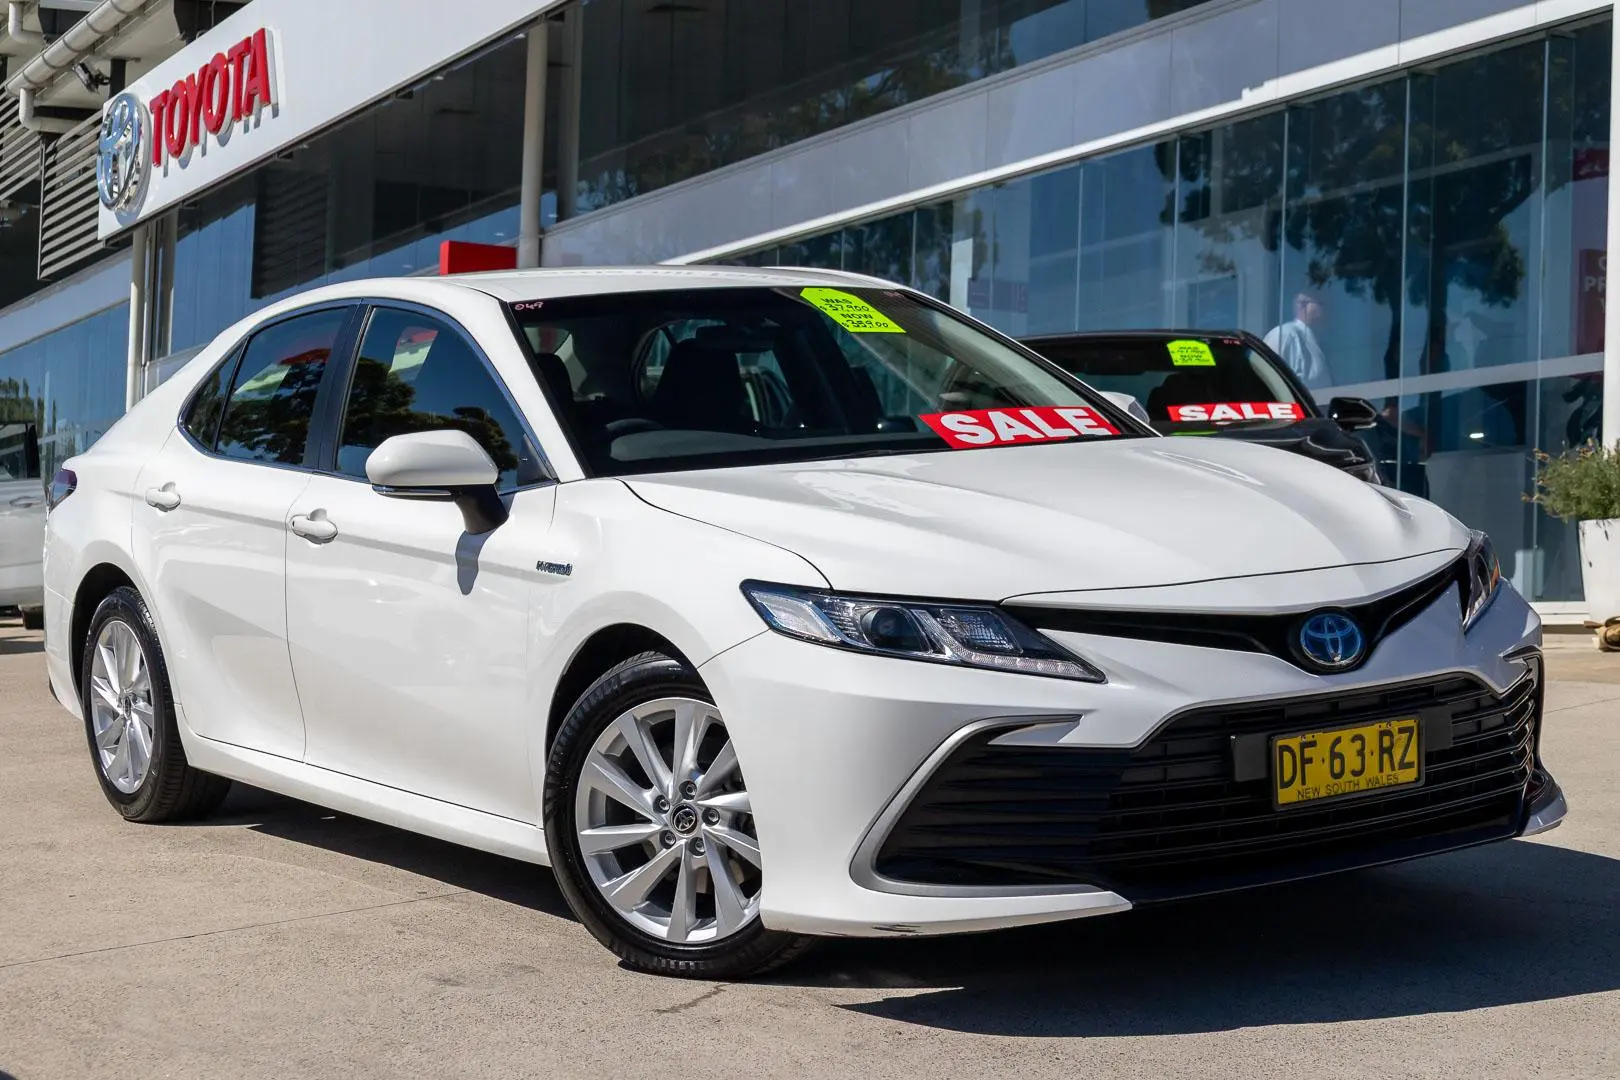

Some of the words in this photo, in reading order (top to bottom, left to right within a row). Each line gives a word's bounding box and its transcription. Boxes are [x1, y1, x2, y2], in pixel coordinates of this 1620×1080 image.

[149, 27, 271, 168] TOYOTA
[940, 408, 1112, 445] SALE
[1178, 403, 1297, 421] SALE
[1297, 786, 1321, 800] NEW
[1326, 780, 1360, 796] SOUTH
[1365, 773, 1399, 787] WALES
